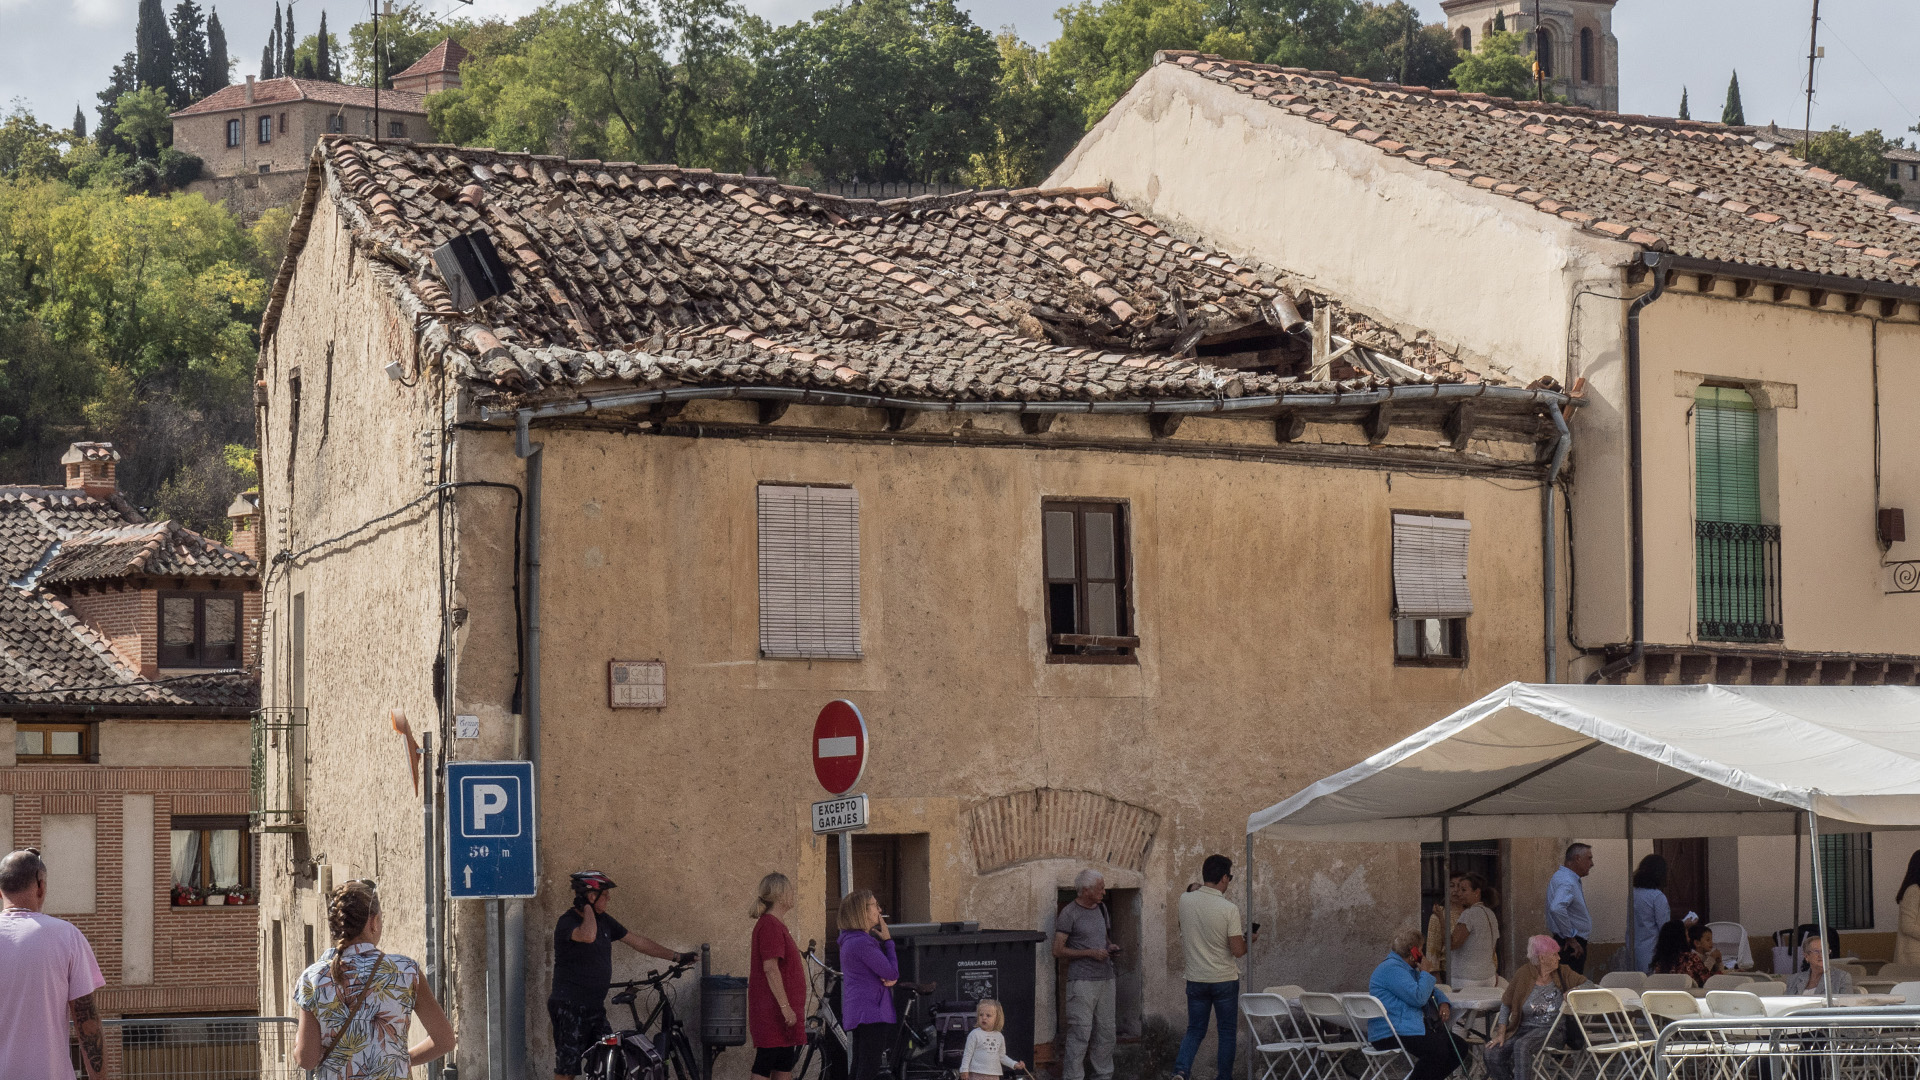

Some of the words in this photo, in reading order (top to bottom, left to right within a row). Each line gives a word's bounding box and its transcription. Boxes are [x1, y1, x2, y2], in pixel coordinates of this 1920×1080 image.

[620, 687, 658, 700] IGLESIA
[473, 784, 508, 830] P
[818, 800, 857, 816] EXCEPTO
[818, 812, 858, 828] GARAJES
[469, 845, 489, 858] 50
